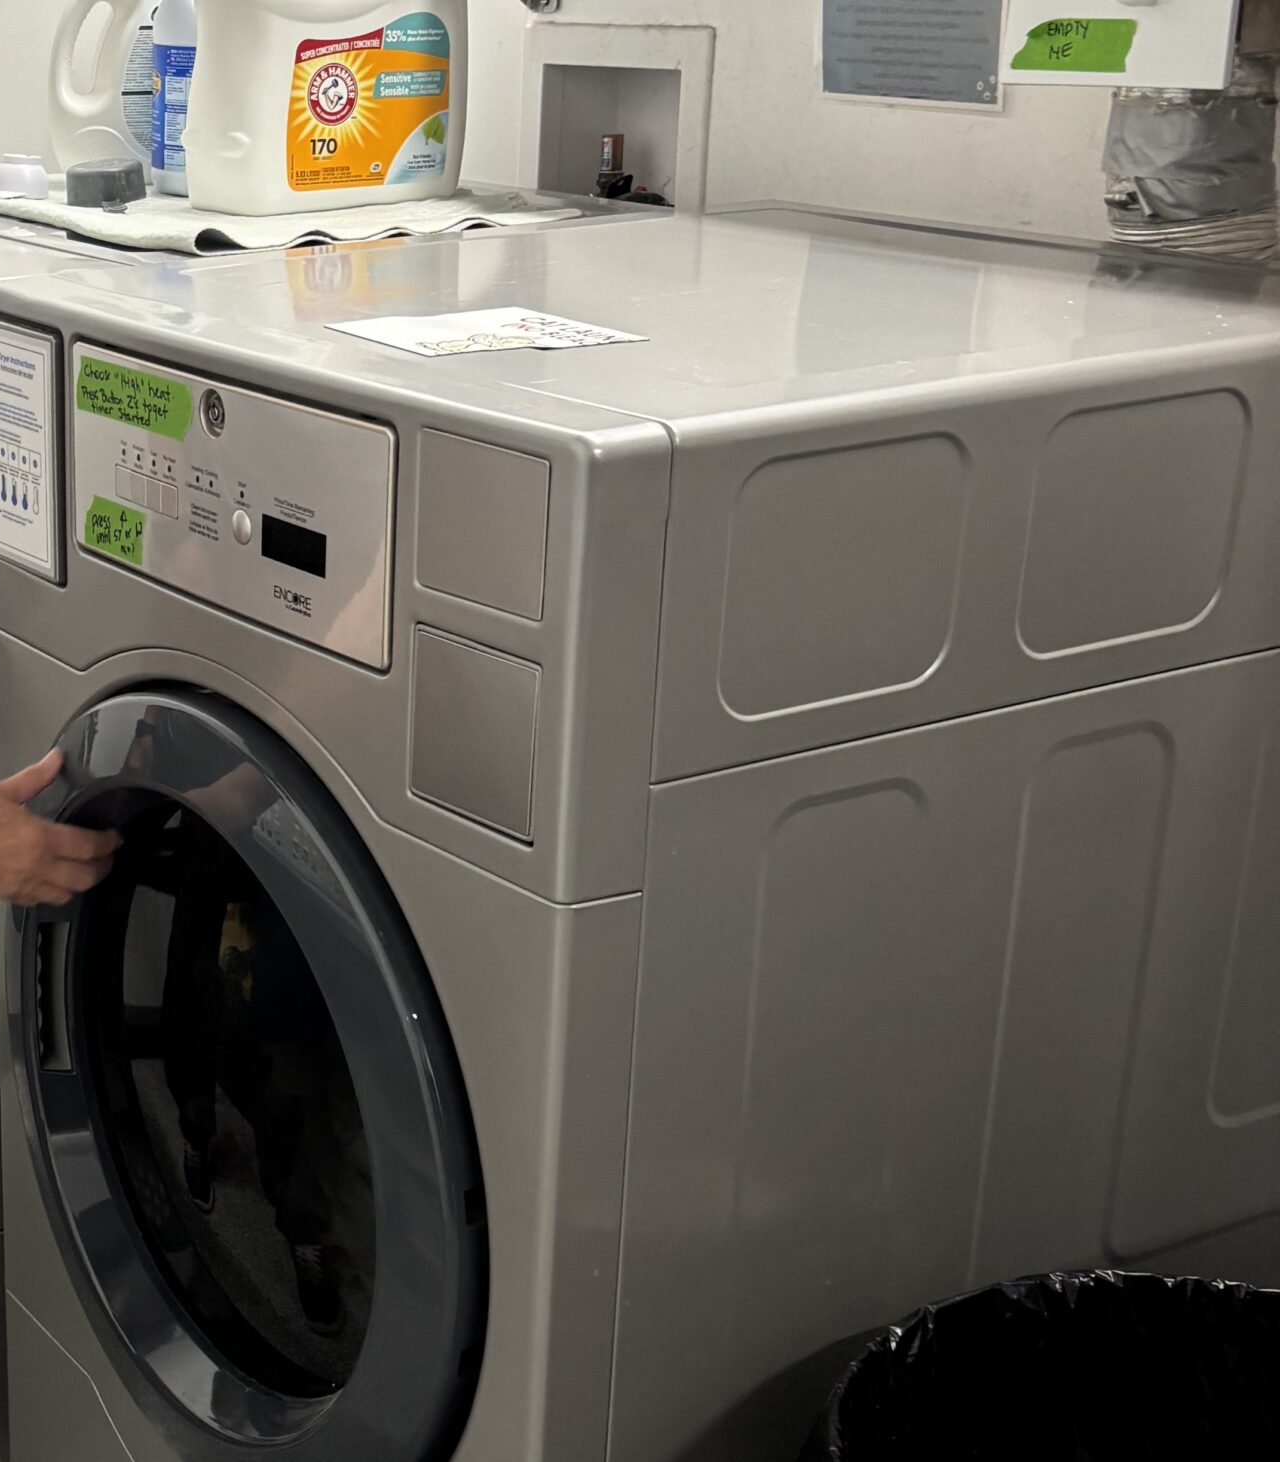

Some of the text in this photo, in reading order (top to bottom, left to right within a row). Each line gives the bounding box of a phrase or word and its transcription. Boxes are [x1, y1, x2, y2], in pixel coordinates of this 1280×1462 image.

[385, 30, 407, 42] 35%
[1047, 20, 1090, 40] EMPTY
[300, 49, 316, 60] SUPER
[316, 42, 349, 56] CONCENTRATED
[1048, 42, 1073, 60] ME
[310, 66, 356, 101] ARM & HAMMER
[380, 72, 412, 83] Sensitive
[380, 85, 410, 96] Sensible
[310, 138, 338, 155] 170
[273, 584, 312, 611] ENCORE
